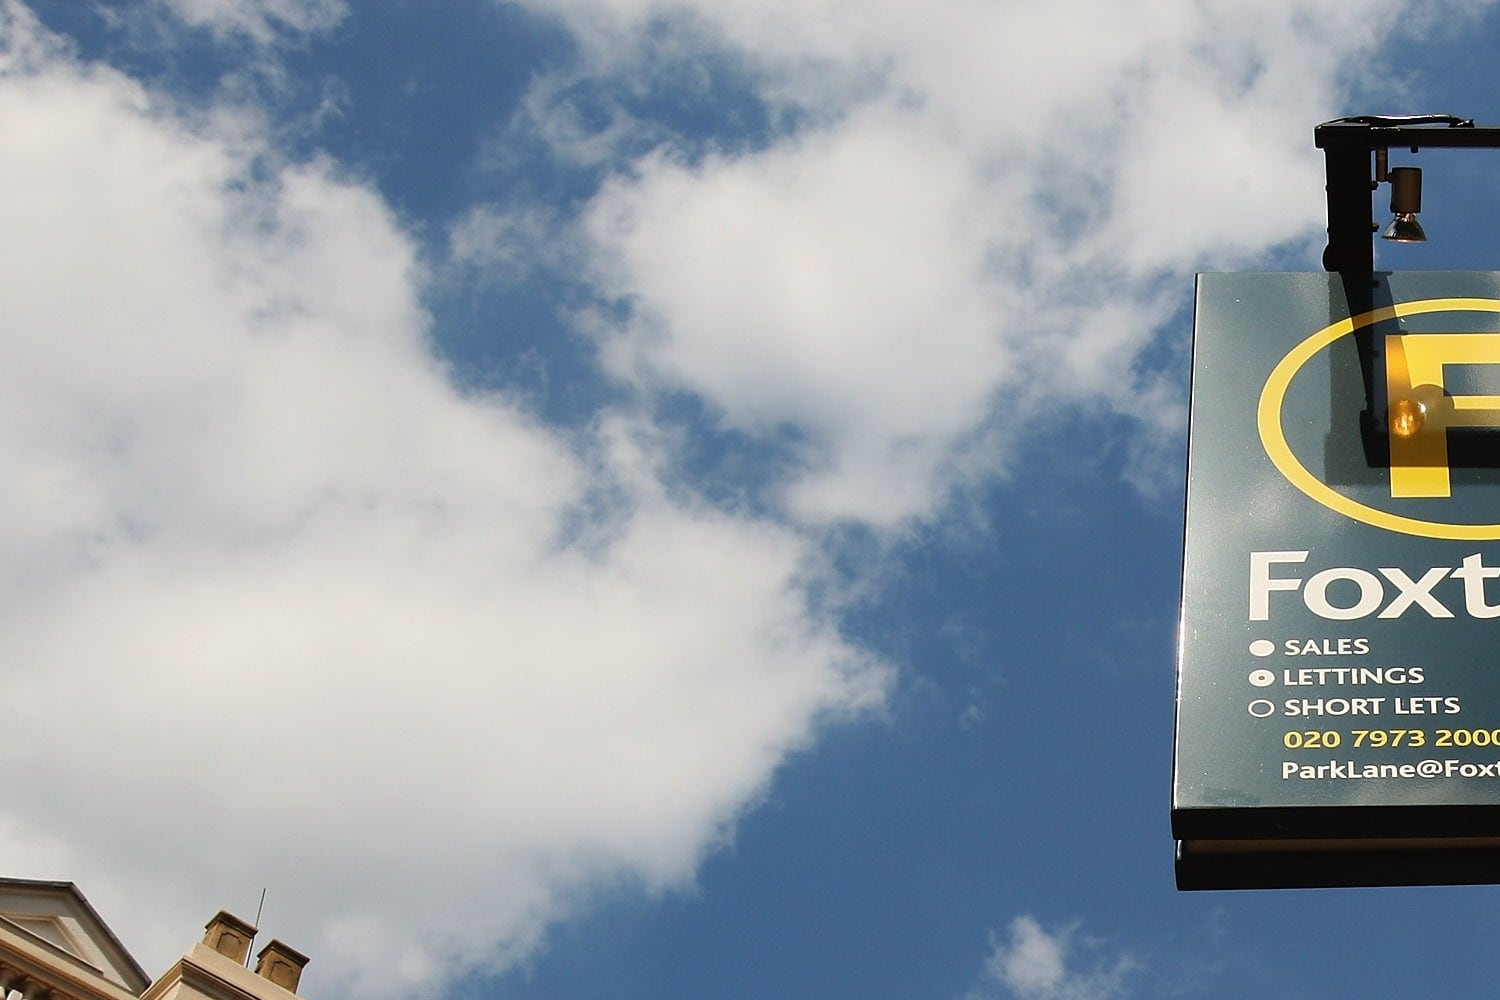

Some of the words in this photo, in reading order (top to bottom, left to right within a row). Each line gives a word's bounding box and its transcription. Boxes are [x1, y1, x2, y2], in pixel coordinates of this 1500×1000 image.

[1284, 638, 1370, 655] SALES
[1283, 667, 1425, 685] LETTINGS
[1284, 698, 1385, 715] SHORT
[1394, 697, 1460, 714] LETS
[1284, 730, 1341, 748] 020
[1350, 729, 1426, 747] 7973
